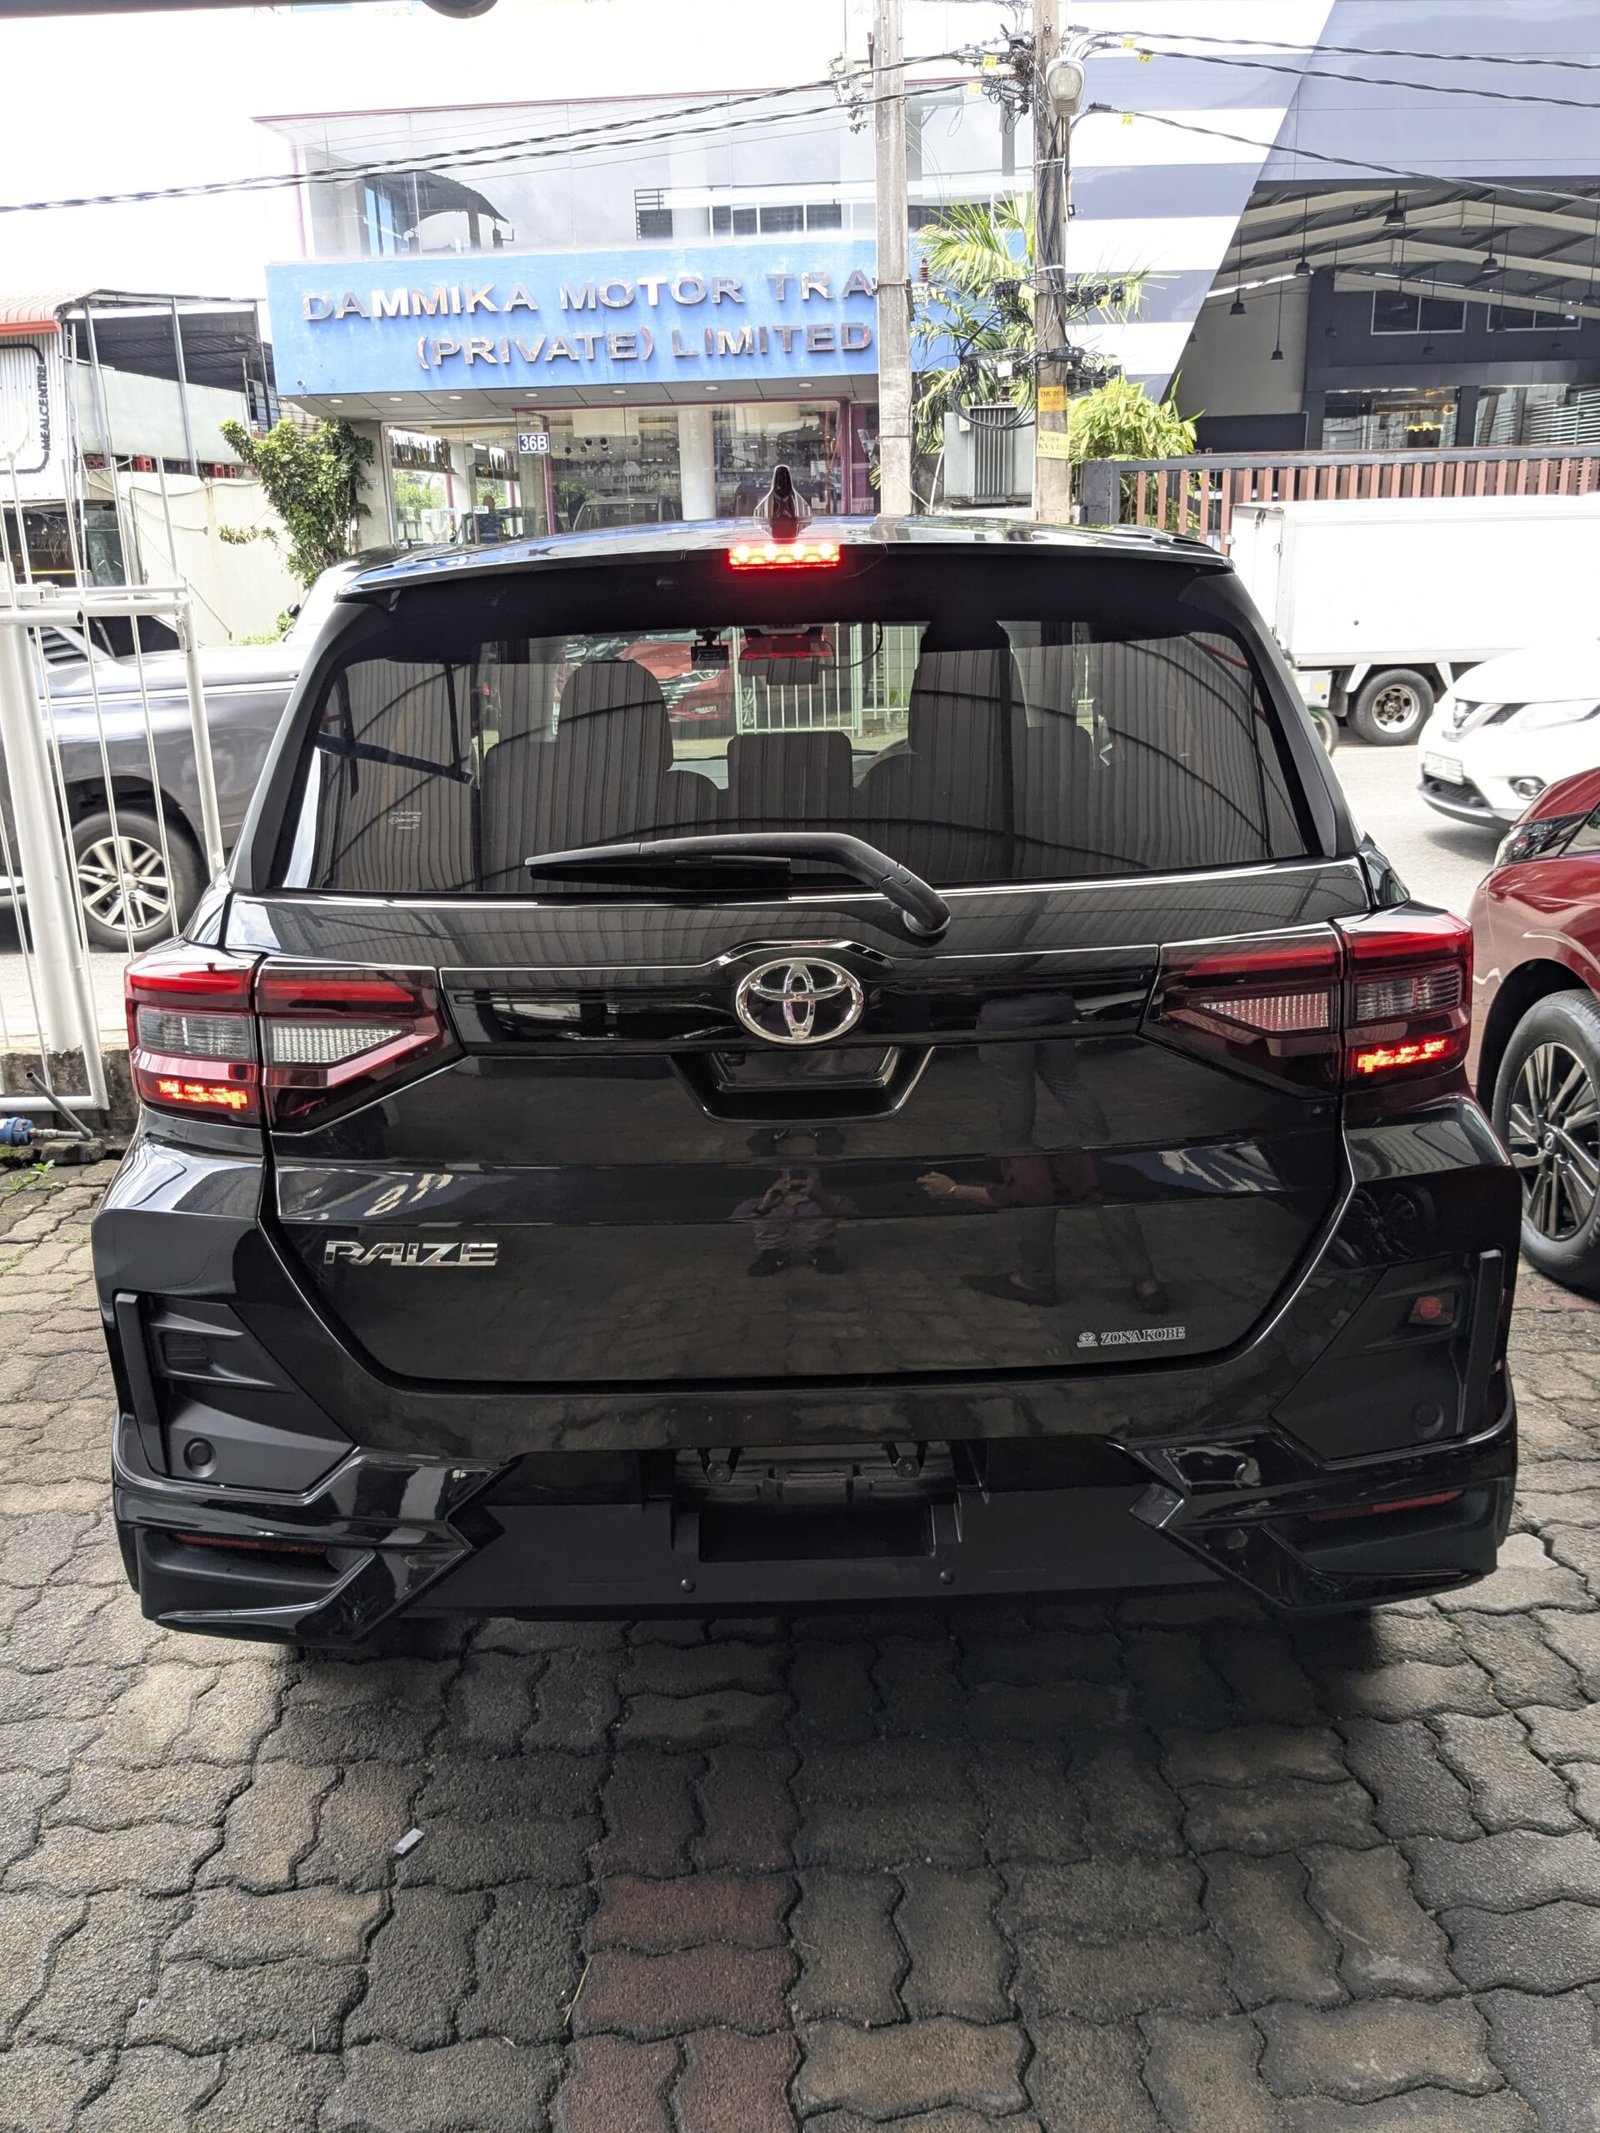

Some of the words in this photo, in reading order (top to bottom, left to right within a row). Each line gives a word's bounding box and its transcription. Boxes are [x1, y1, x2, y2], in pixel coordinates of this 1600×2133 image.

[302, 282, 538, 321] DAMMIKA
[560, 275, 745, 310] MOTOR
[766, 269, 874, 301] TRA
[416, 326, 653, 370] (PRIVATE)
[672, 322, 872, 356] LIMITED
[521, 435, 547, 451] 36B
[324, 1240, 498, 1266] RAIZE
